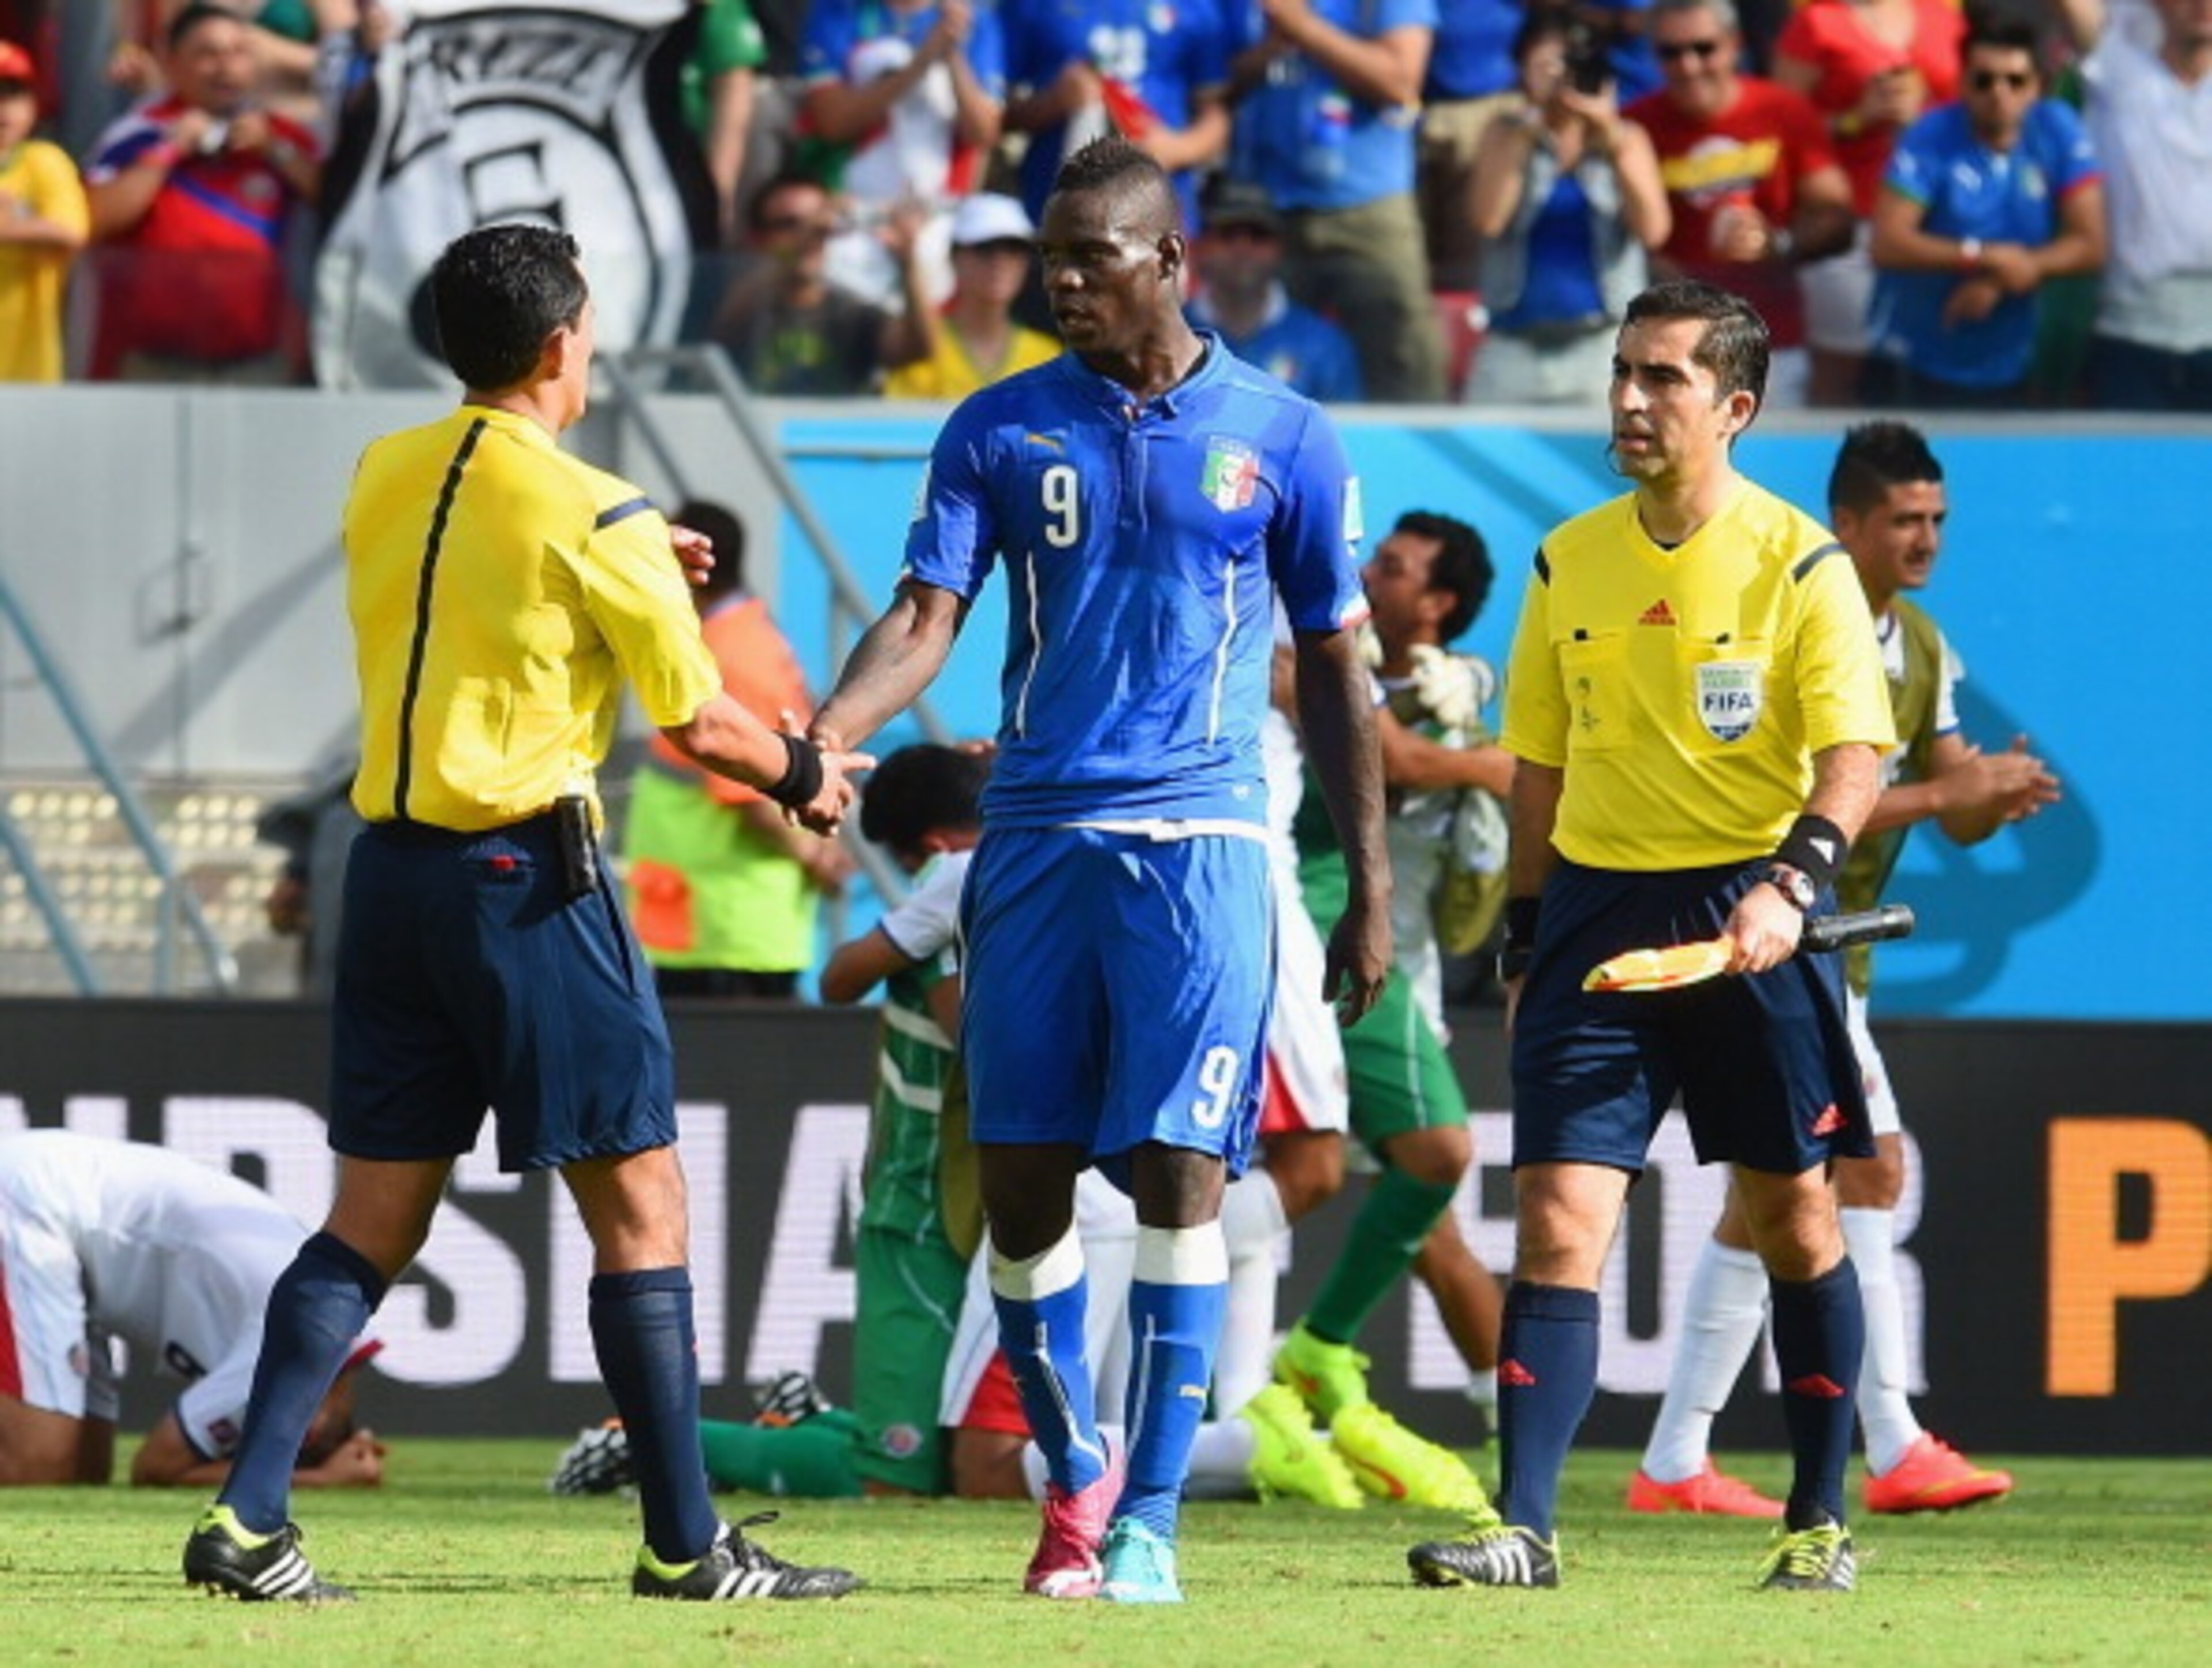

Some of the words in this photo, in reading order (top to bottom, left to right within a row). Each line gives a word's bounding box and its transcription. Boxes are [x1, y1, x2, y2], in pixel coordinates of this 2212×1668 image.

[1041, 465, 1078, 547] 9
[1703, 692, 1753, 712] FIFA
[1191, 1045, 1239, 1128] 9
